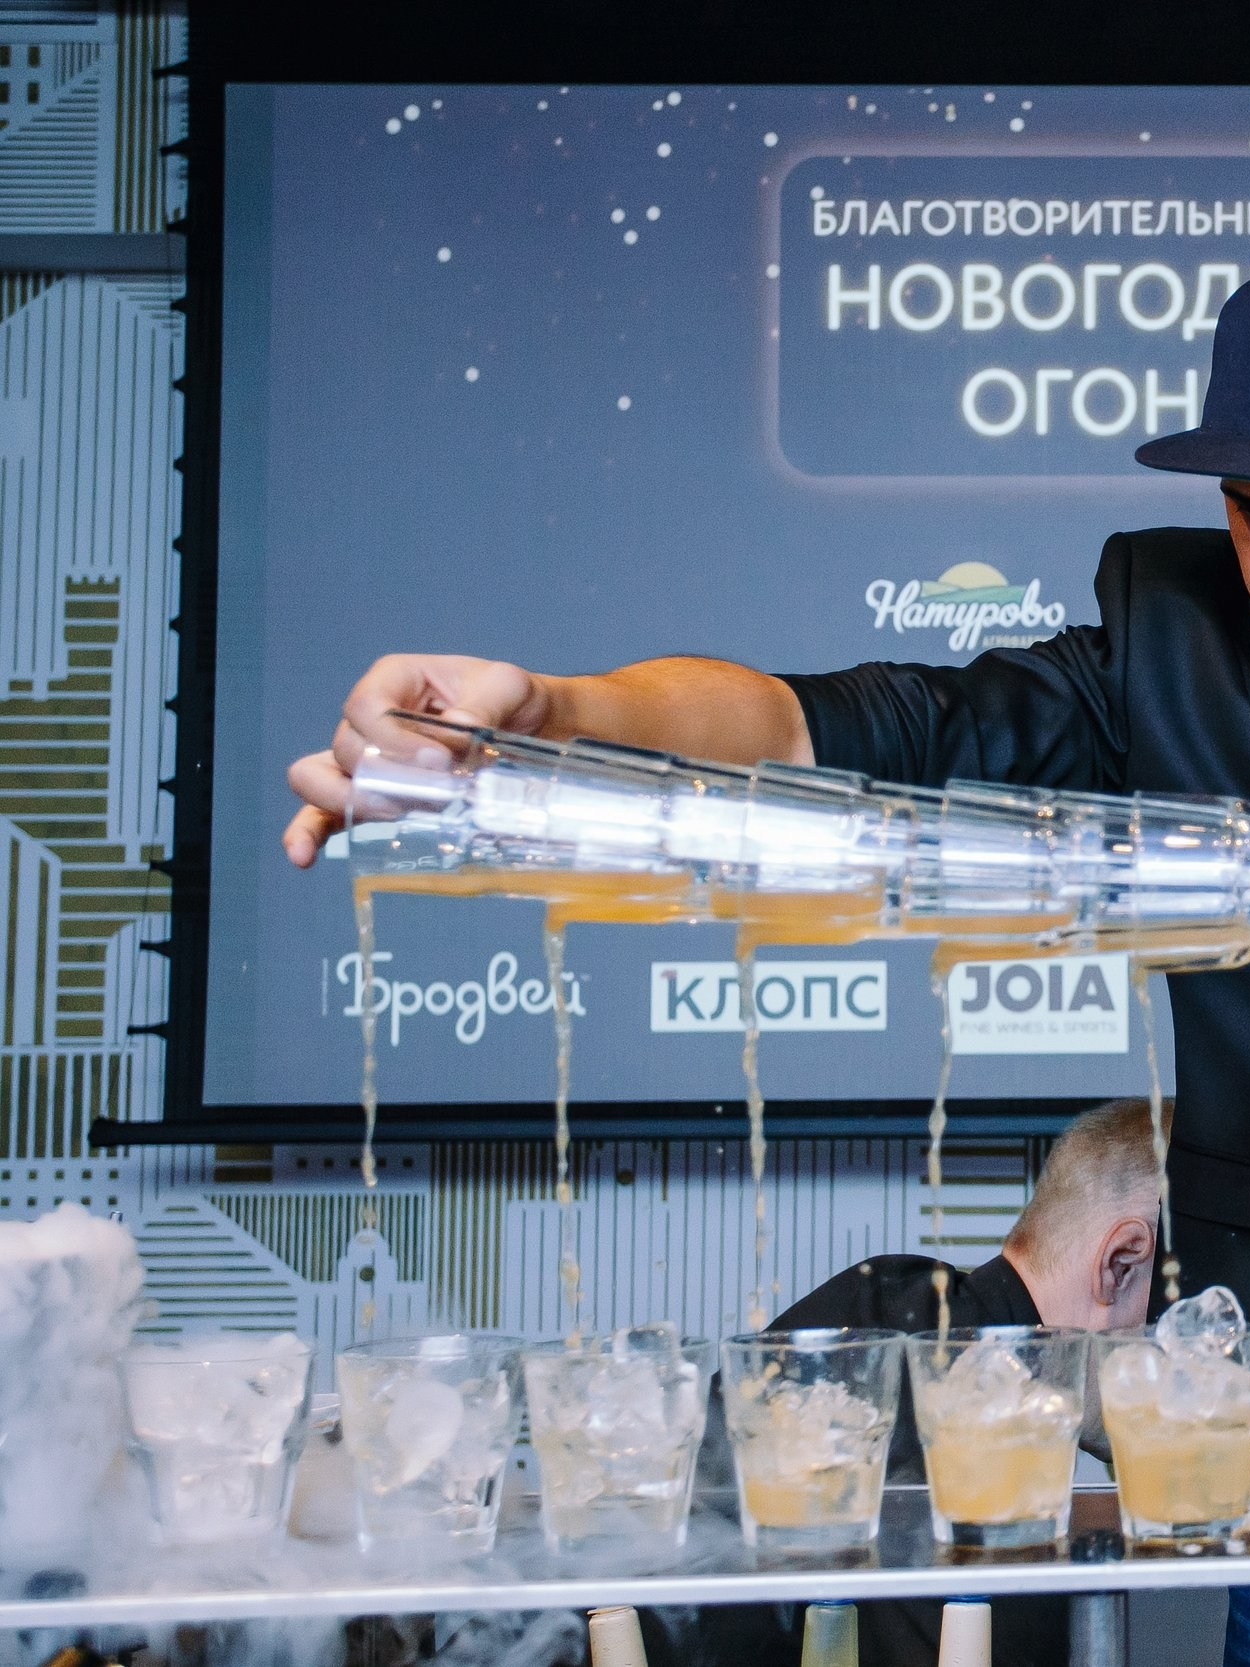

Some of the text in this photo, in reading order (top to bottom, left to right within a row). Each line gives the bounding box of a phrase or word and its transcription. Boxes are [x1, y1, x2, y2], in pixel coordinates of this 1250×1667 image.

[961, 367, 1200, 436] ОГОН
[865, 577, 1066, 651] Натурово
[336, 951, 586, 1046] Бродвей
[666, 975, 880, 1021] КЛОПС
[960, 964, 1116, 1013] JOIA
[996, 1022, 1043, 1034] WINES
